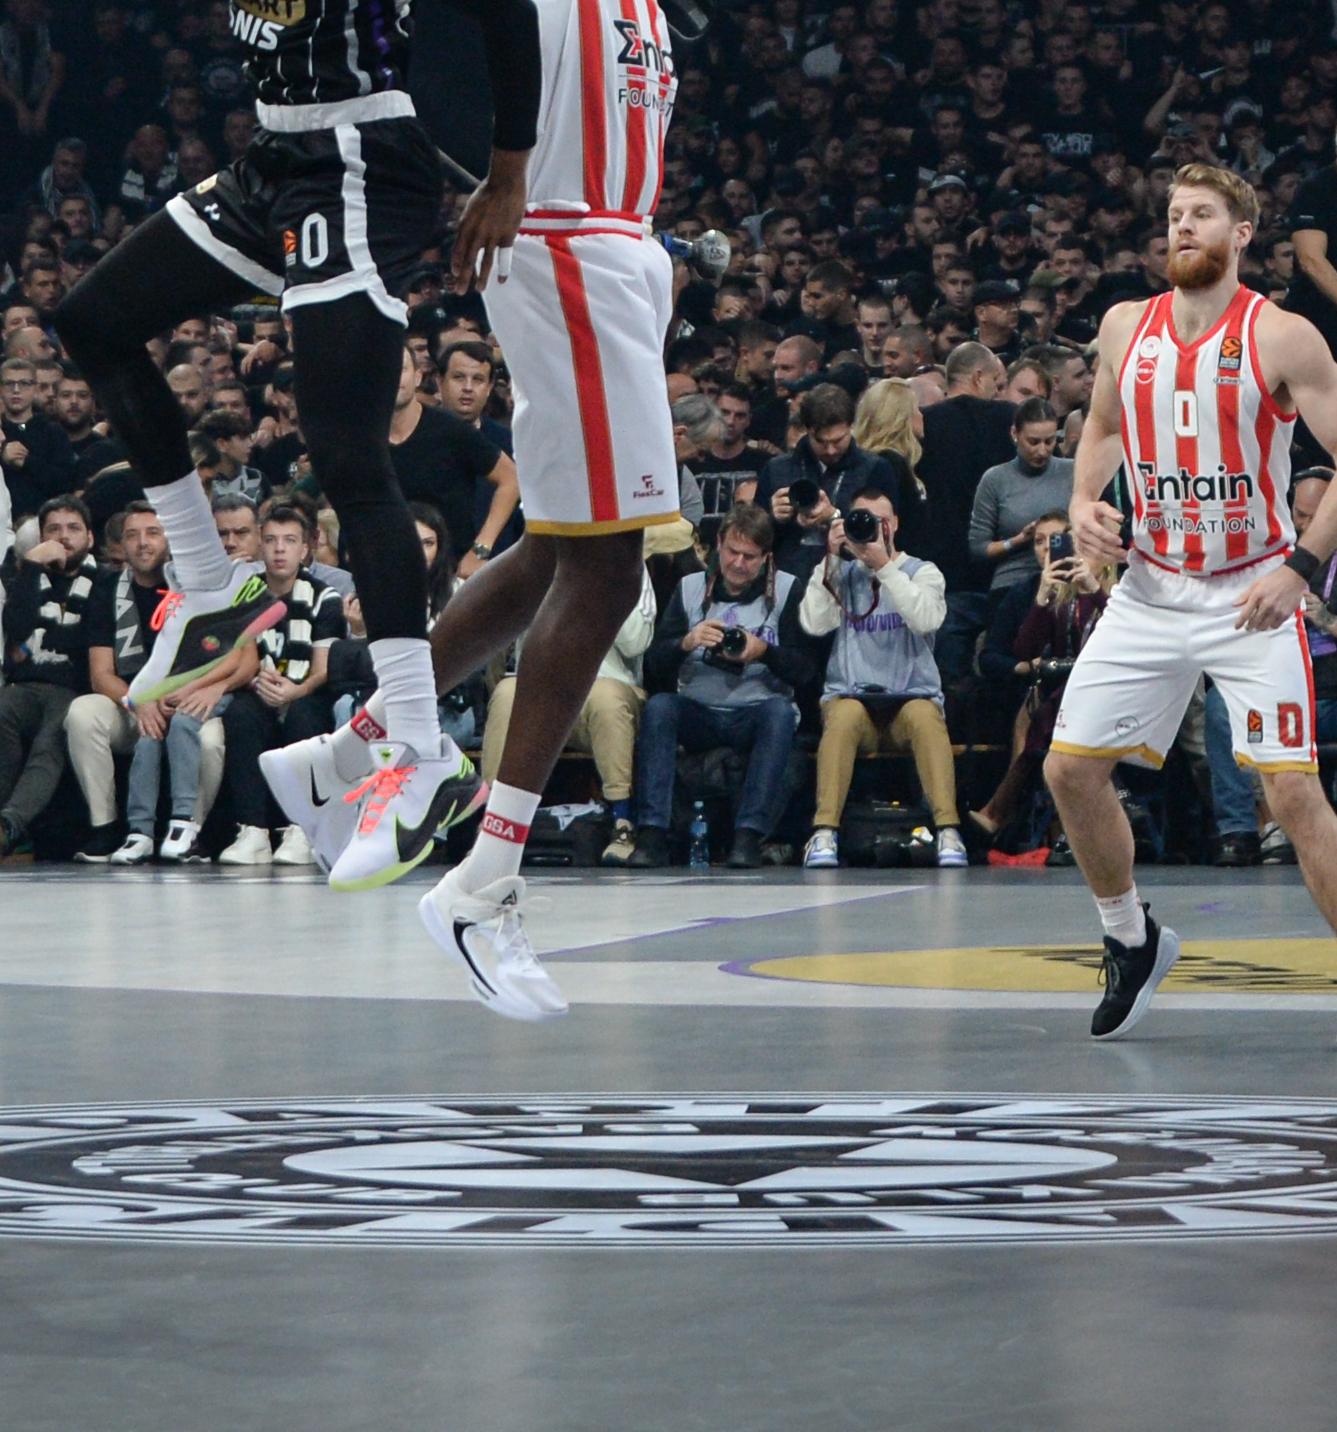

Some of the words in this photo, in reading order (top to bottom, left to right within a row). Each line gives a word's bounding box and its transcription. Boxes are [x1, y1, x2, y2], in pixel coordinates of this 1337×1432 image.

[302, 212, 328, 268] 0
[1173, 390, 1200, 438] 0
[1277, 702, 1303, 748] 0
[483, 813, 517, 841] GSA
